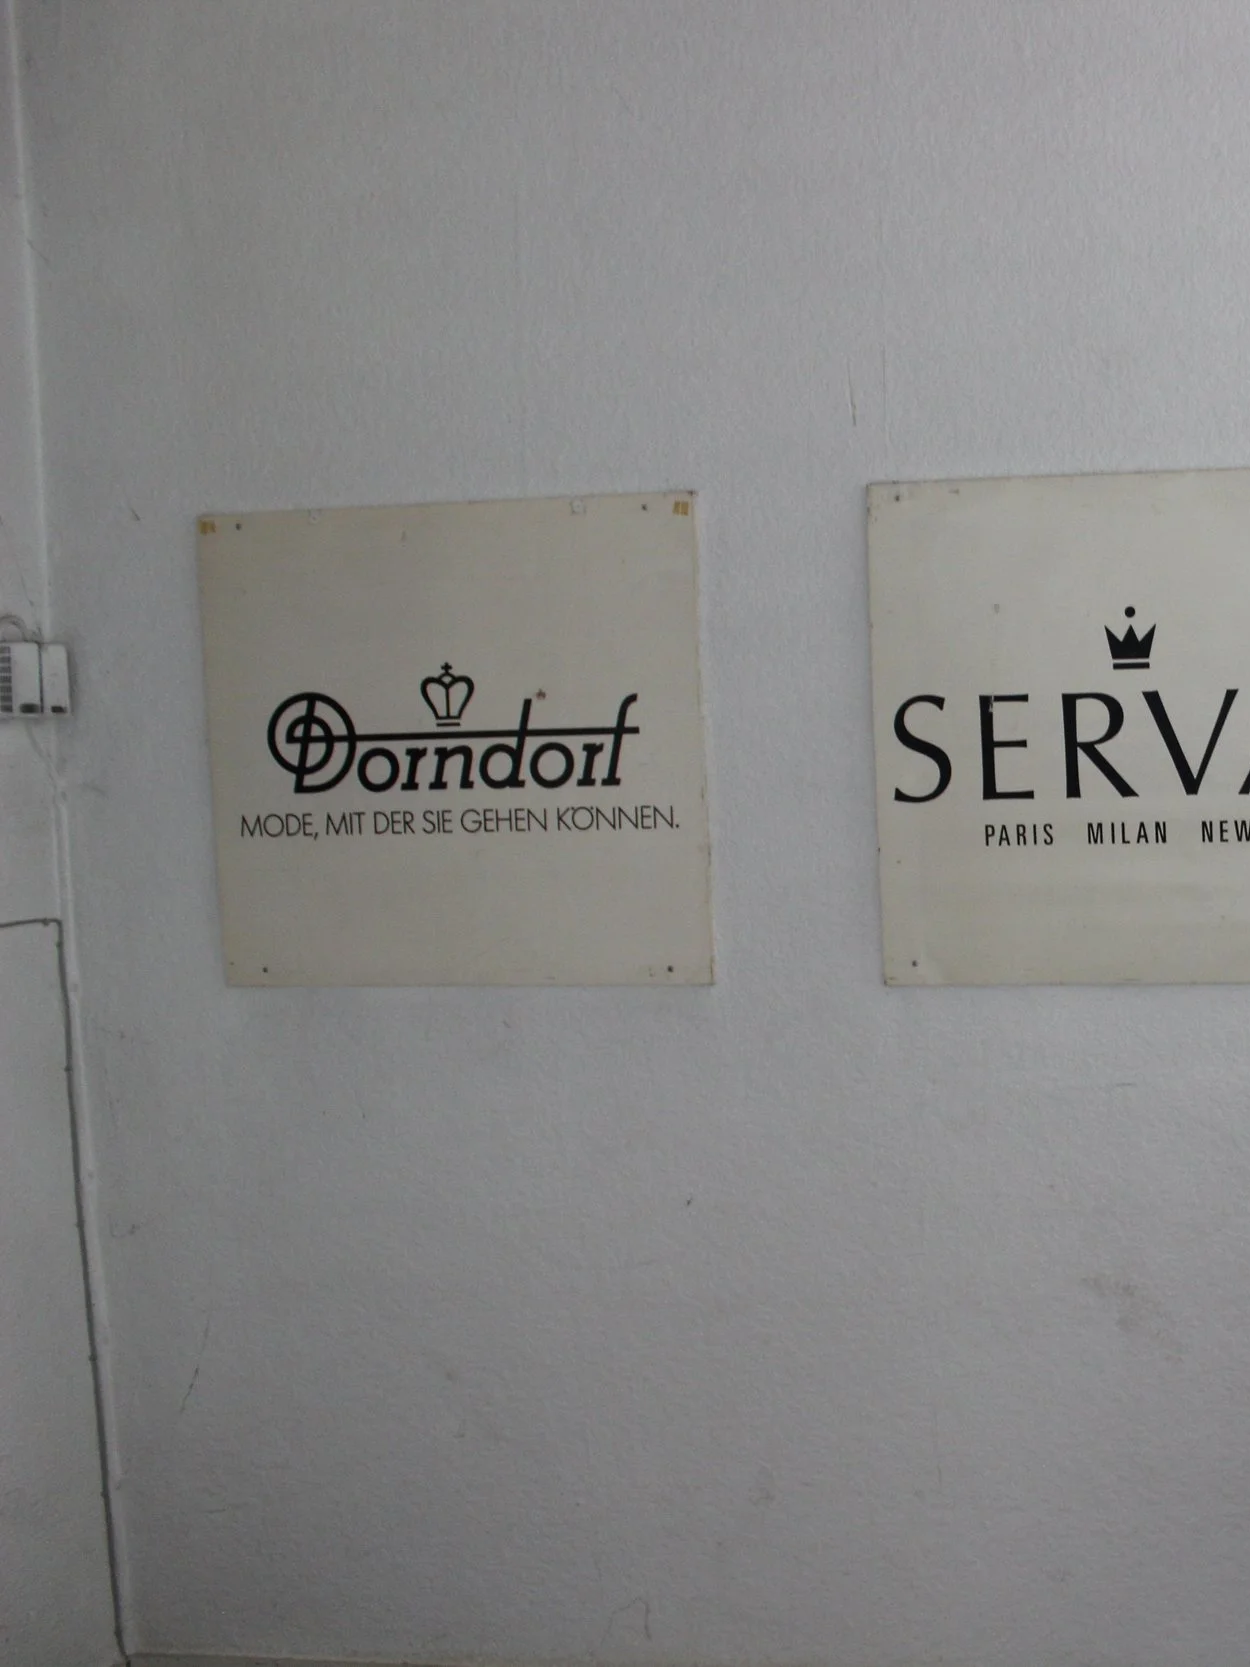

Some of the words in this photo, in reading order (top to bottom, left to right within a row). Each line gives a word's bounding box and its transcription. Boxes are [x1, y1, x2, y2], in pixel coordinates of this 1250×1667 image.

[267, 691, 640, 795] Dorndorf
[240, 812, 319, 841] MODE,
[326, 811, 367, 837] MIT
[373, 809, 416, 836] DER
[421, 809, 454, 835] SIE
[460, 807, 548, 834] GEHEN
[556, 804, 681, 832] KÖNNEN.
[984, 823, 1055, 847] PARIS
[1087, 821, 1168, 845] MILAN
